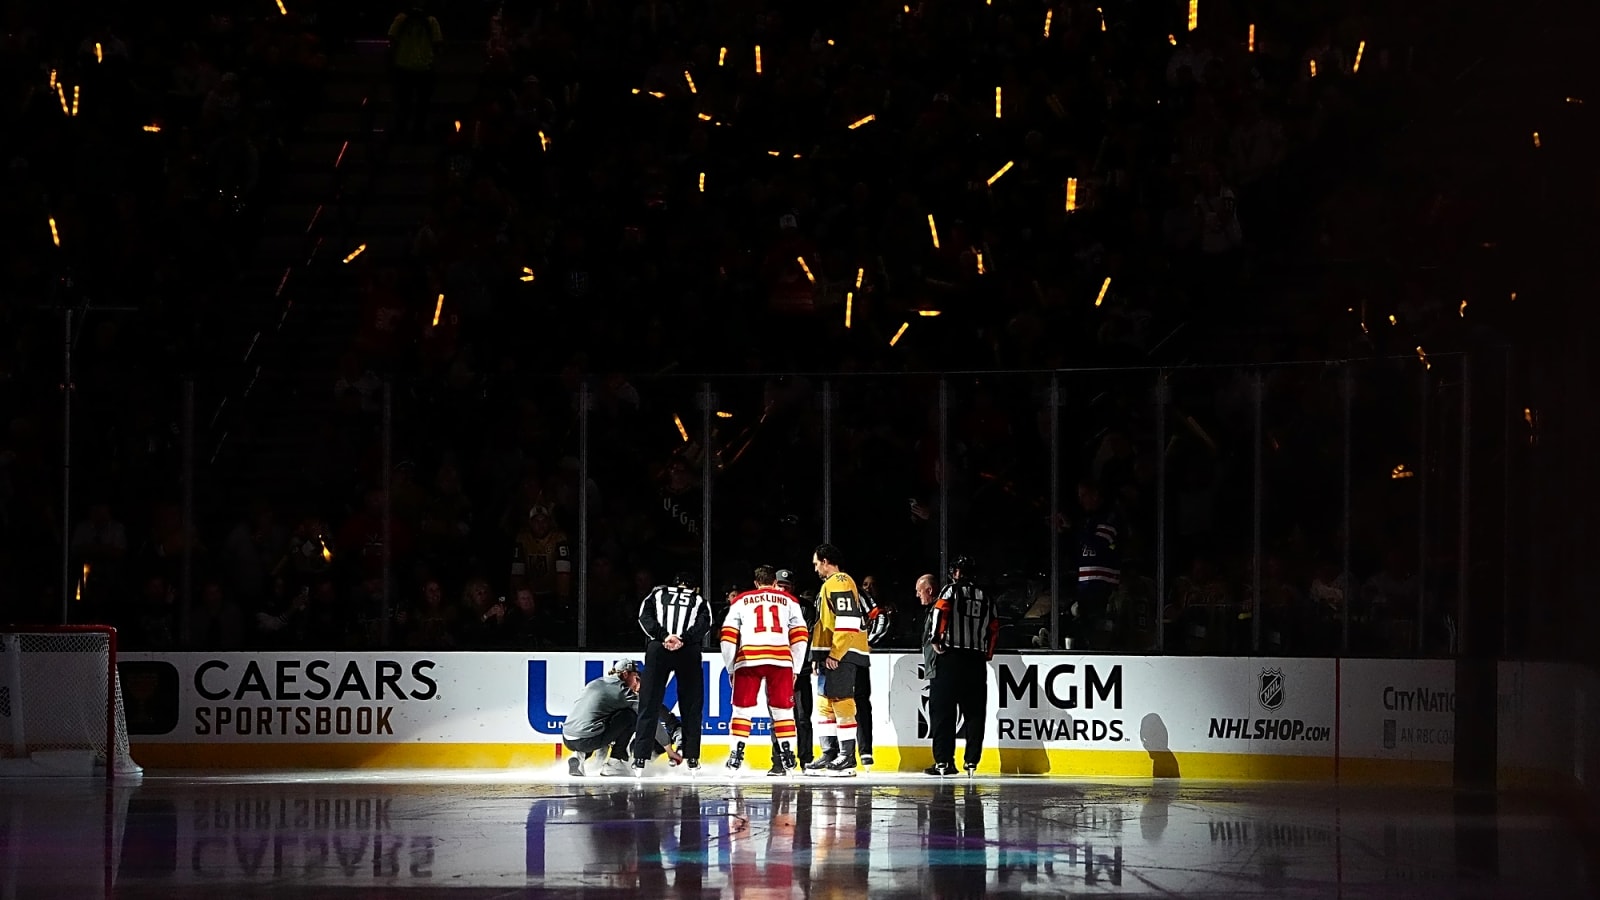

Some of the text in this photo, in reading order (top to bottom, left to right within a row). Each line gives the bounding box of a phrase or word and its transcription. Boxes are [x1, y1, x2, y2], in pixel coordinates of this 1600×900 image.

[668, 591, 691, 606] 75
[744, 594, 788, 606] BACKLUND
[836, 598, 854, 611] 61
[965, 599, 982, 617] 18
[754, 605, 783, 633] 11
[194, 660, 437, 700] CAESARS
[999, 665, 1121, 709] MGM
[1264, 680, 1280, 702] NHL
[195, 707, 393, 735] SPORTSBOOK
[998, 719, 1123, 741] REWARDS
